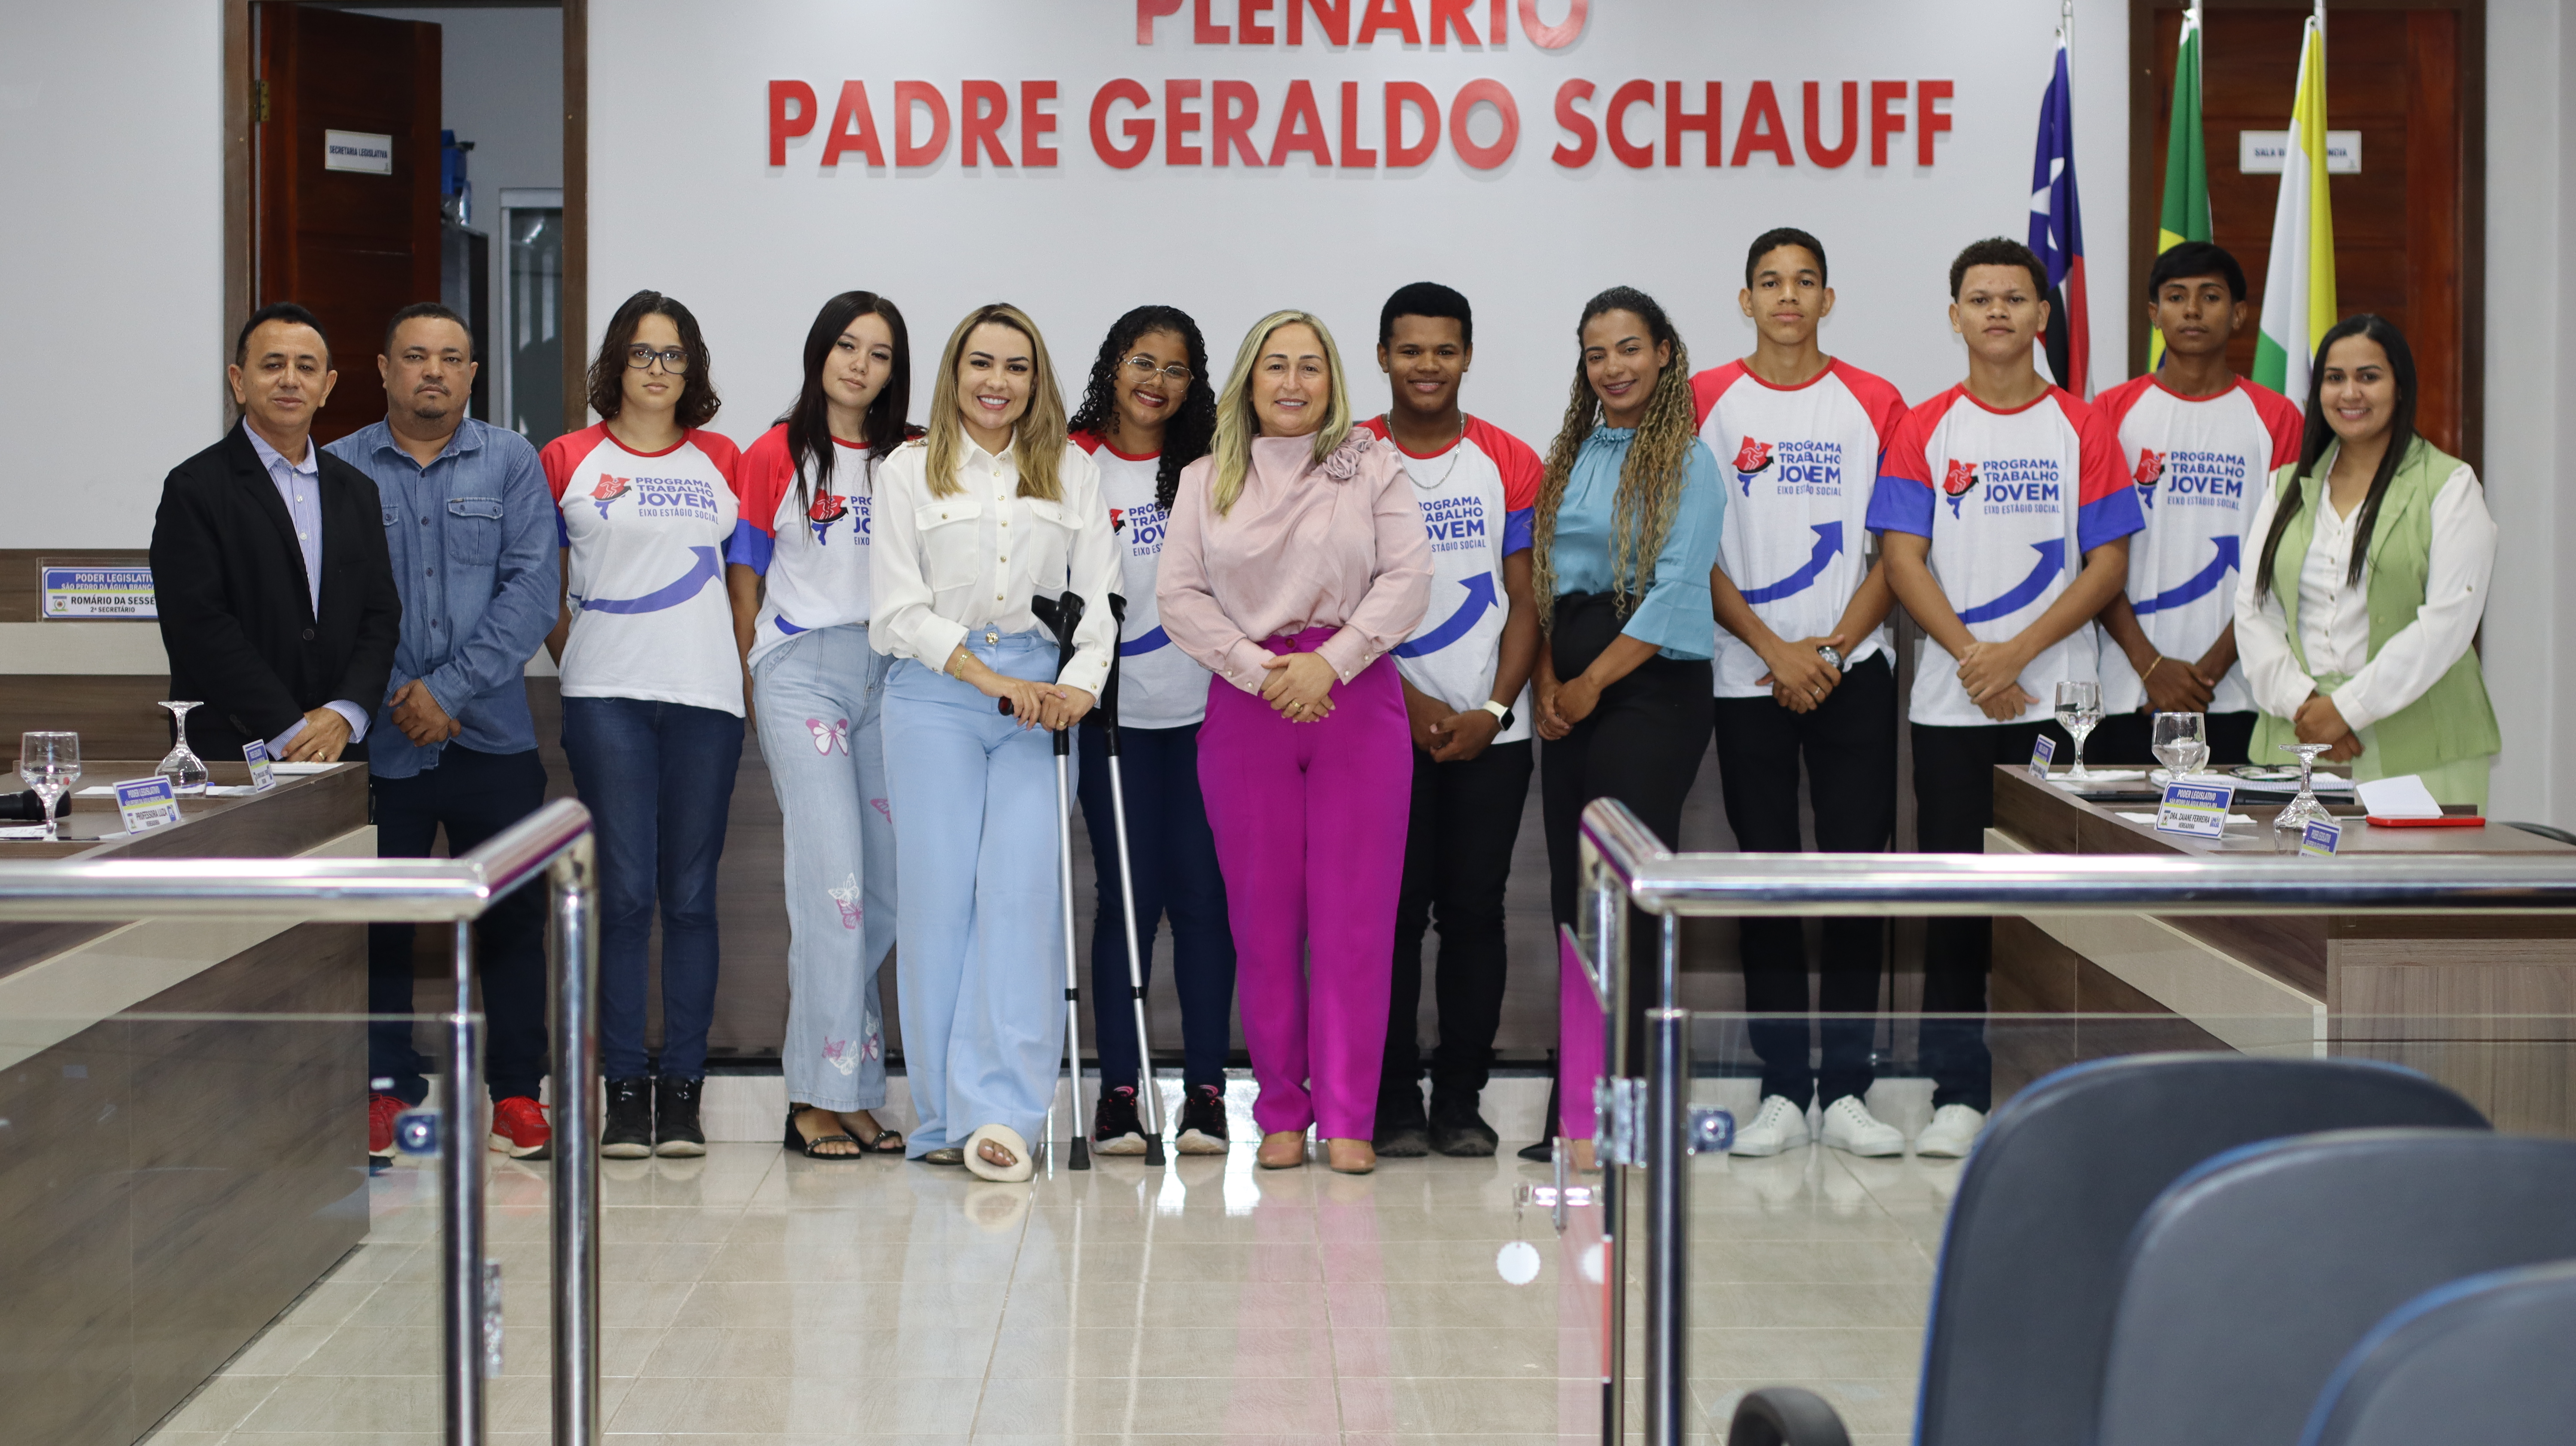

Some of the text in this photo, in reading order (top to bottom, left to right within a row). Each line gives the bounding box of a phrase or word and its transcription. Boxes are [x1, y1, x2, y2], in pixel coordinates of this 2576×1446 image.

[769, 78, 1954, 170] PADRE GERALDO SCHAUFF
[329, 145, 387, 158] SECRETARIA LEGISLATIVA
[1983, 459, 2059, 471] PROGRAMA
[2171, 452, 2245, 466] PROGRAMA
[1777, 464, 1841, 484] JOVEM
[1984, 471, 2059, 482] TRABALHO
[2171, 462, 2245, 478] TRABALHO
[635, 477, 712, 490] PROGRAMA
[2168, 475, 2243, 498] JOVEM
[637, 485, 714, 498] TRABALHO
[1777, 486, 1794, 495] EIXO
[1816, 486, 1842, 496] SOCIAL
[1984, 483, 2059, 502] JOVEM
[638, 492, 718, 514] JOVEM
[1418, 496, 1482, 511] OGRAMA
[1984, 503, 2060, 514] EIXO ESTÁGIO SOCIAL
[2168, 495, 2240, 511] EIXO ESTÁGIO SOCIAL
[639, 507, 719, 525] EIXO ESTÁGIO SOCIAL
[1424, 507, 1484, 523] ABALHO
[1132, 521, 1168, 544] JOV
[854, 537, 870, 546] EIXO
[1432, 539, 1486, 553] STÁGIO SOCIAL
[1133, 547, 1151, 557] EIXO
[75, 574, 153, 583] PODER LEGISLATIV
[109, 582, 128, 590] ÁGUA
[71, 594, 112, 605] ROMÁRIO
[128, 595, 155, 605] SESSÉ
[2177, 789, 2217, 802] PODER LEGISLATIVO
[135, 809, 159, 821] PROFESSORA
[2169, 812, 2210, 823] DRA. ZAIANE FERREIRA
